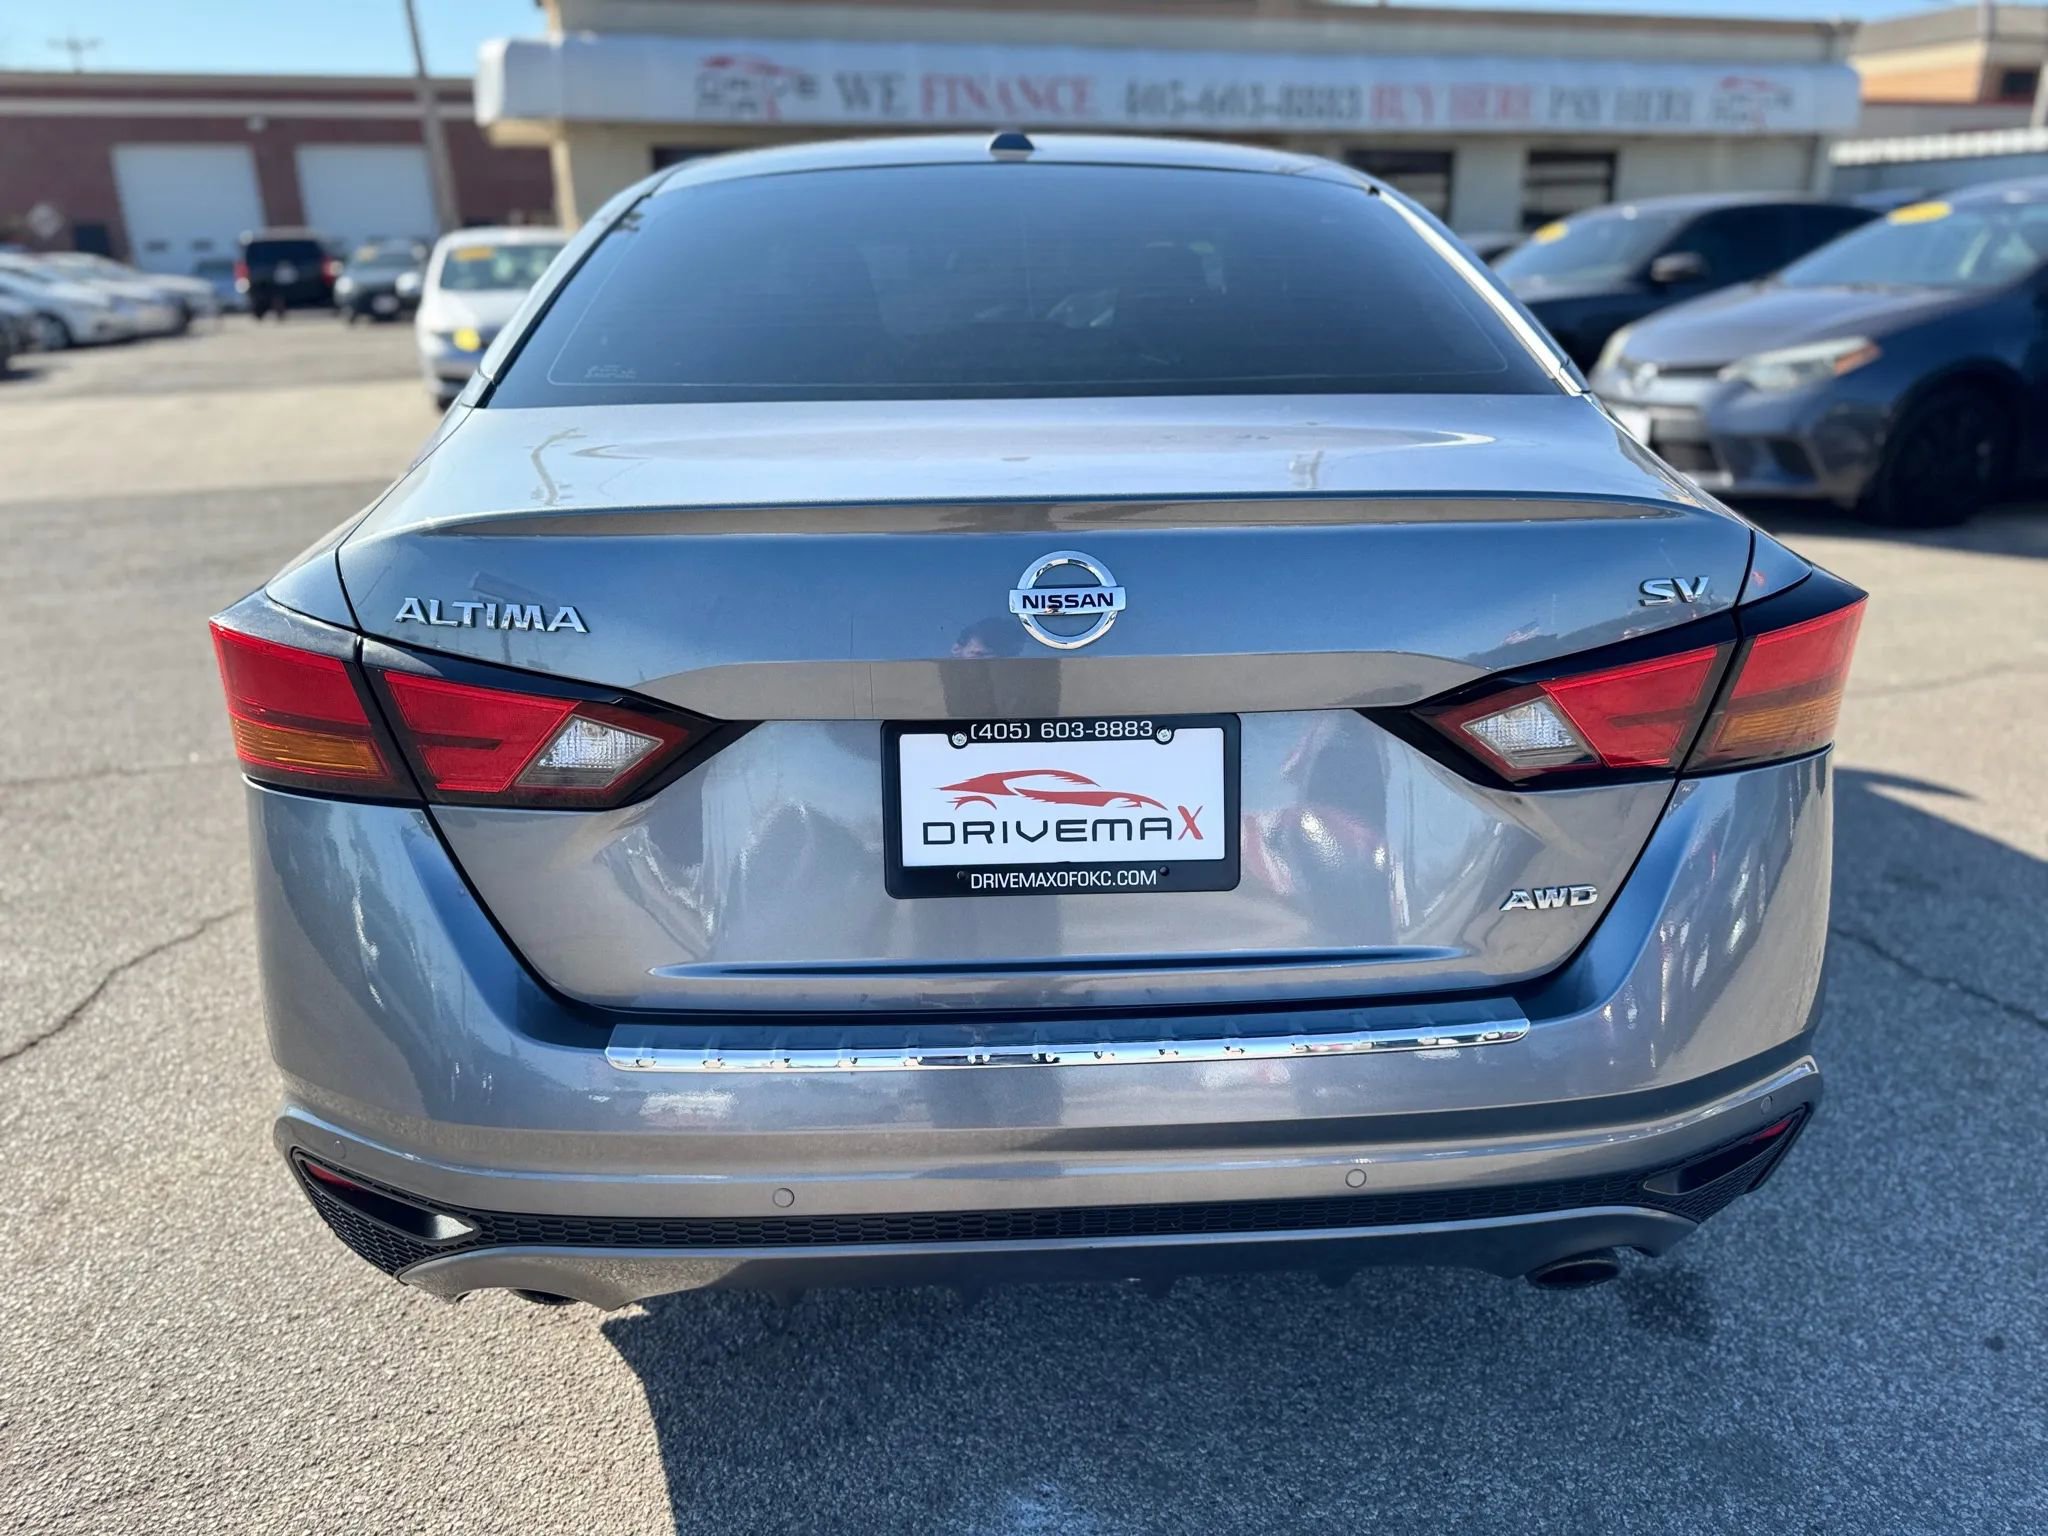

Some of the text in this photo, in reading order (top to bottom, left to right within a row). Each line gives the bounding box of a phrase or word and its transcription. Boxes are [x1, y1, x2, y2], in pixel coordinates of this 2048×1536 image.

[1022, 592, 1114, 609] NISSAN
[1639, 576, 1709, 606] SV
[394, 597, 591, 633] ALTIMA
[970, 720, 1153, 740] (405) 603-8883
[922, 805, 1203, 844] DRIVEMAX
[970, 869, 1157, 889] DRIVEMAXOFOKC.COM
[1500, 884, 1599, 911] AWD
